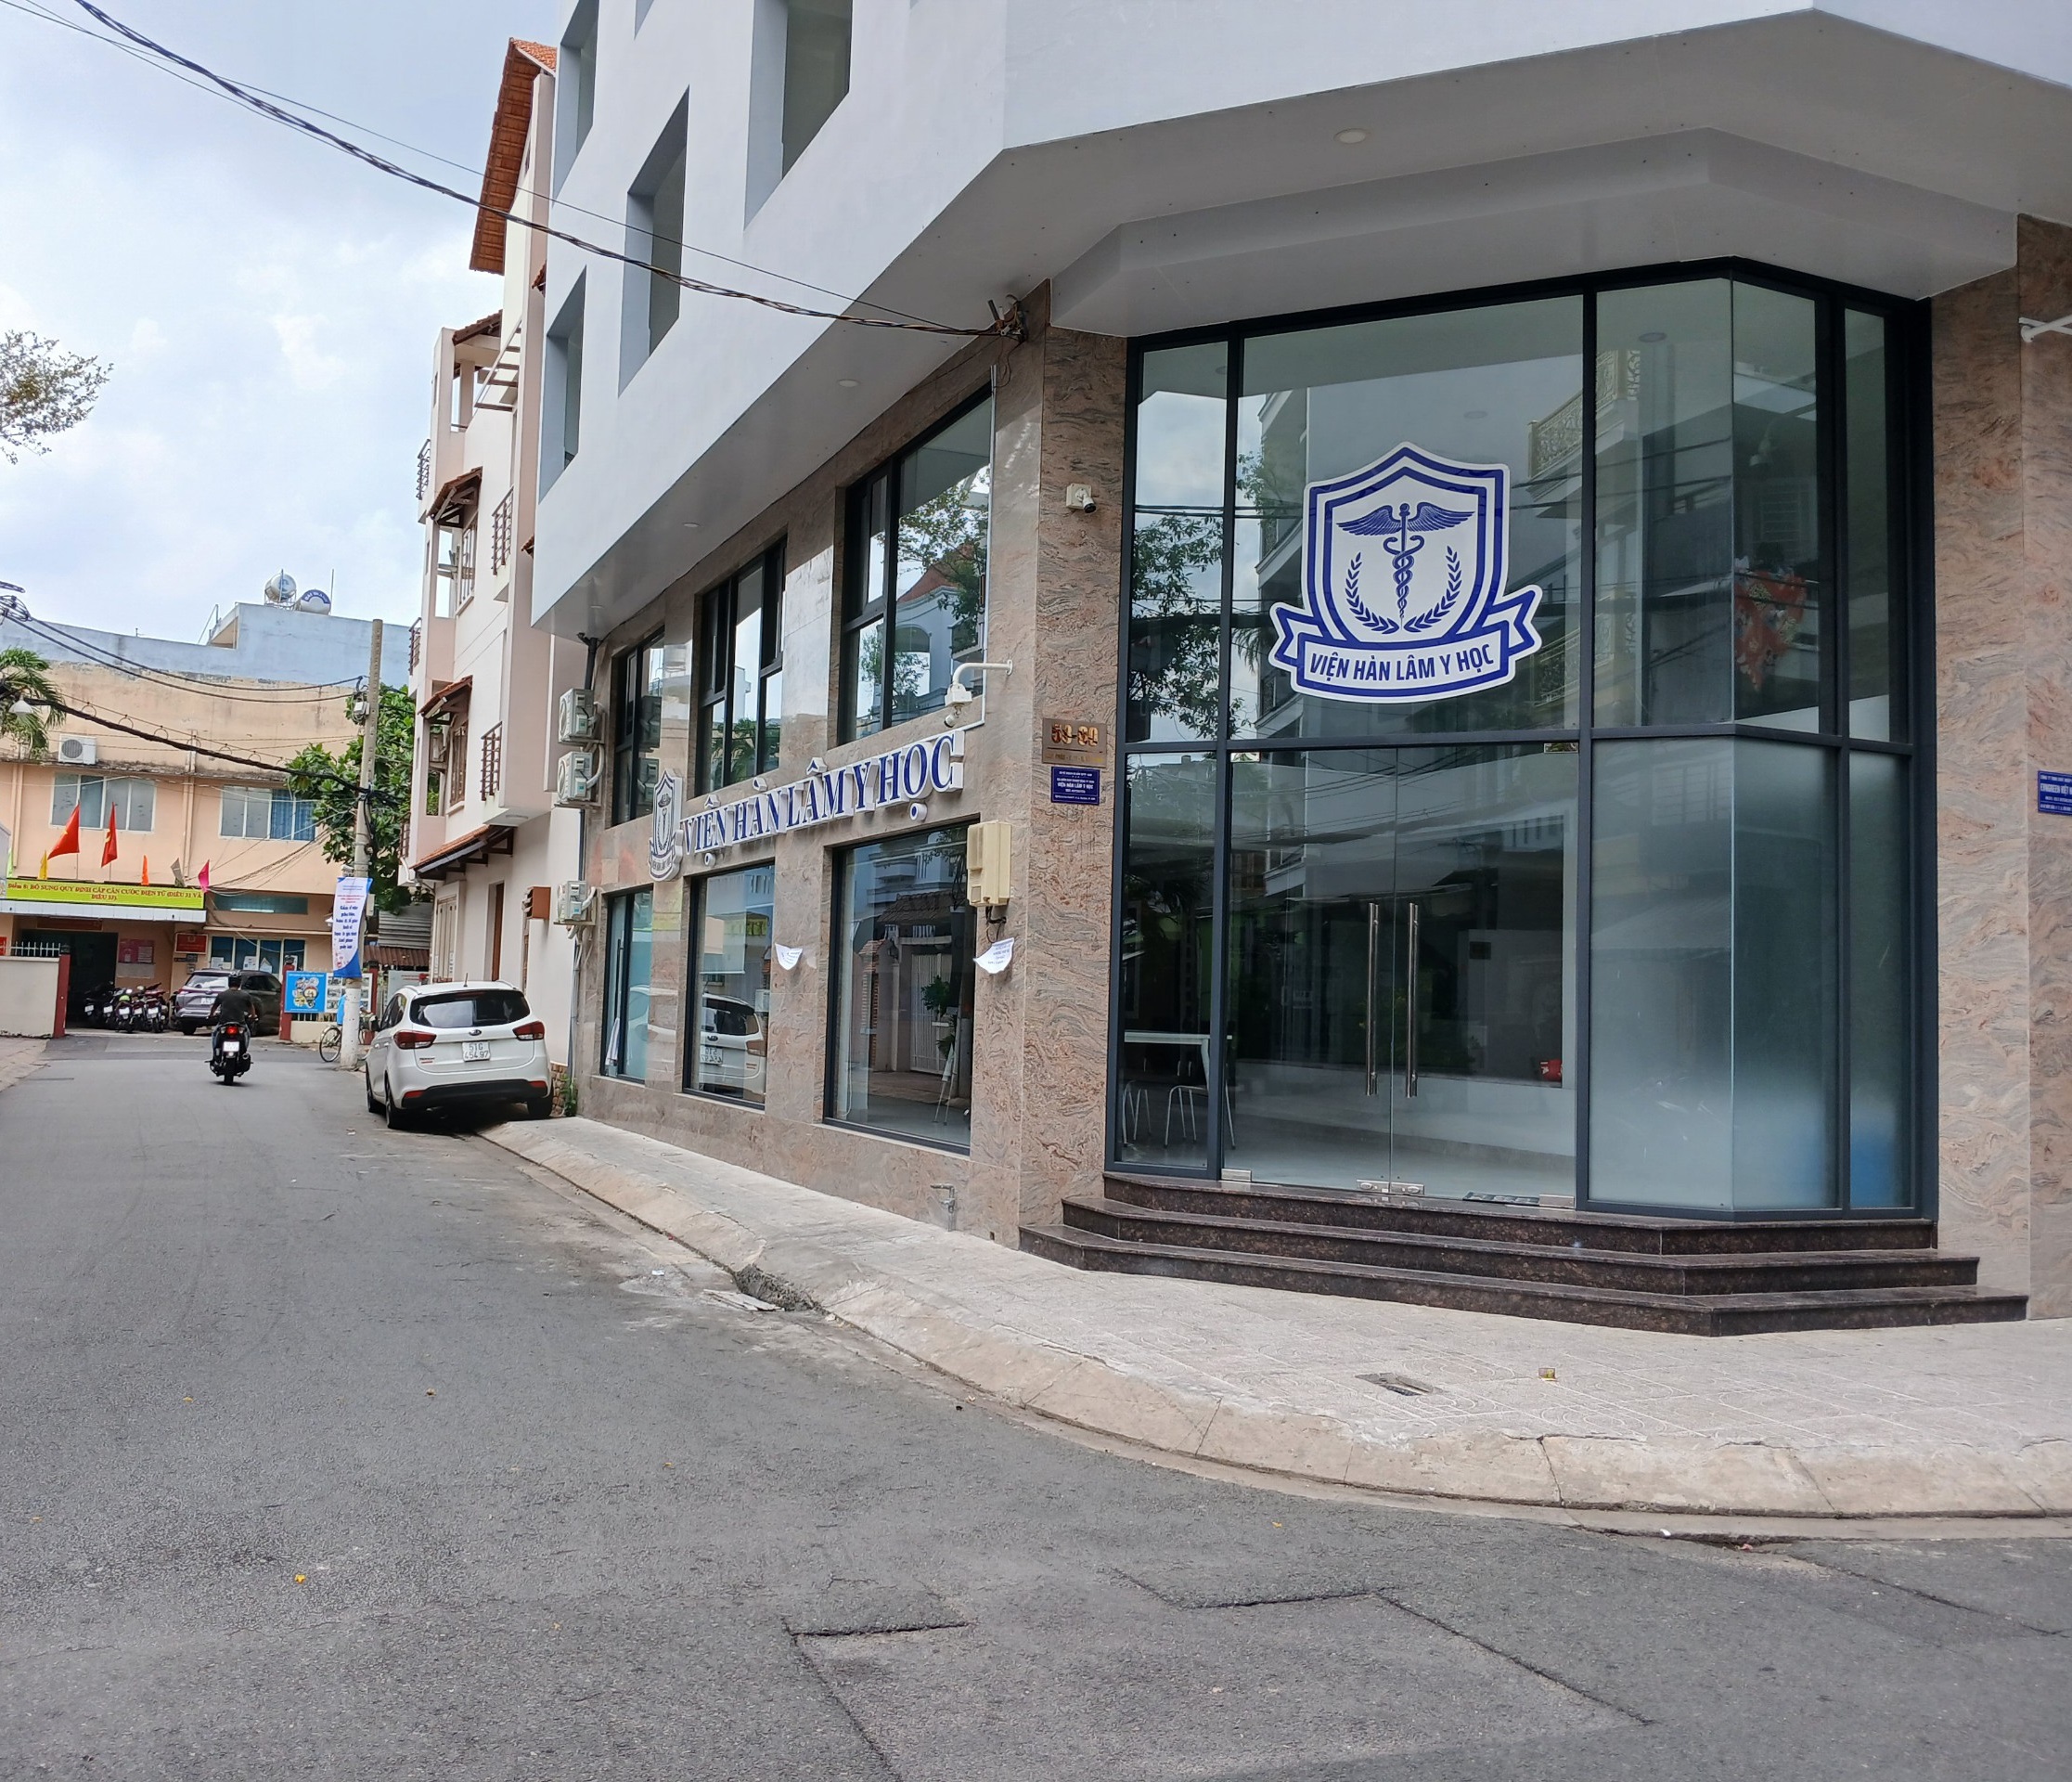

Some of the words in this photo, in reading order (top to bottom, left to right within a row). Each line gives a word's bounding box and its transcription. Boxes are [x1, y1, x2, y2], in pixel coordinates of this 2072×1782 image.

[1309, 651, 1350, 681] VIỆN
[1353, 654, 1391, 681] HÀN
[1396, 654, 1435, 681] LÂM
[1439, 653, 1451, 675] Y
[1456, 643, 1494, 673] HỌC
[682, 795, 728, 863] VIỆN
[732, 780, 782, 843] HÀN
[786, 760, 847, 829] LÂM
[852, 760, 872, 811] Y
[877, 732, 956, 819] HỌC
[469, 1042, 483, 1052] 51G
